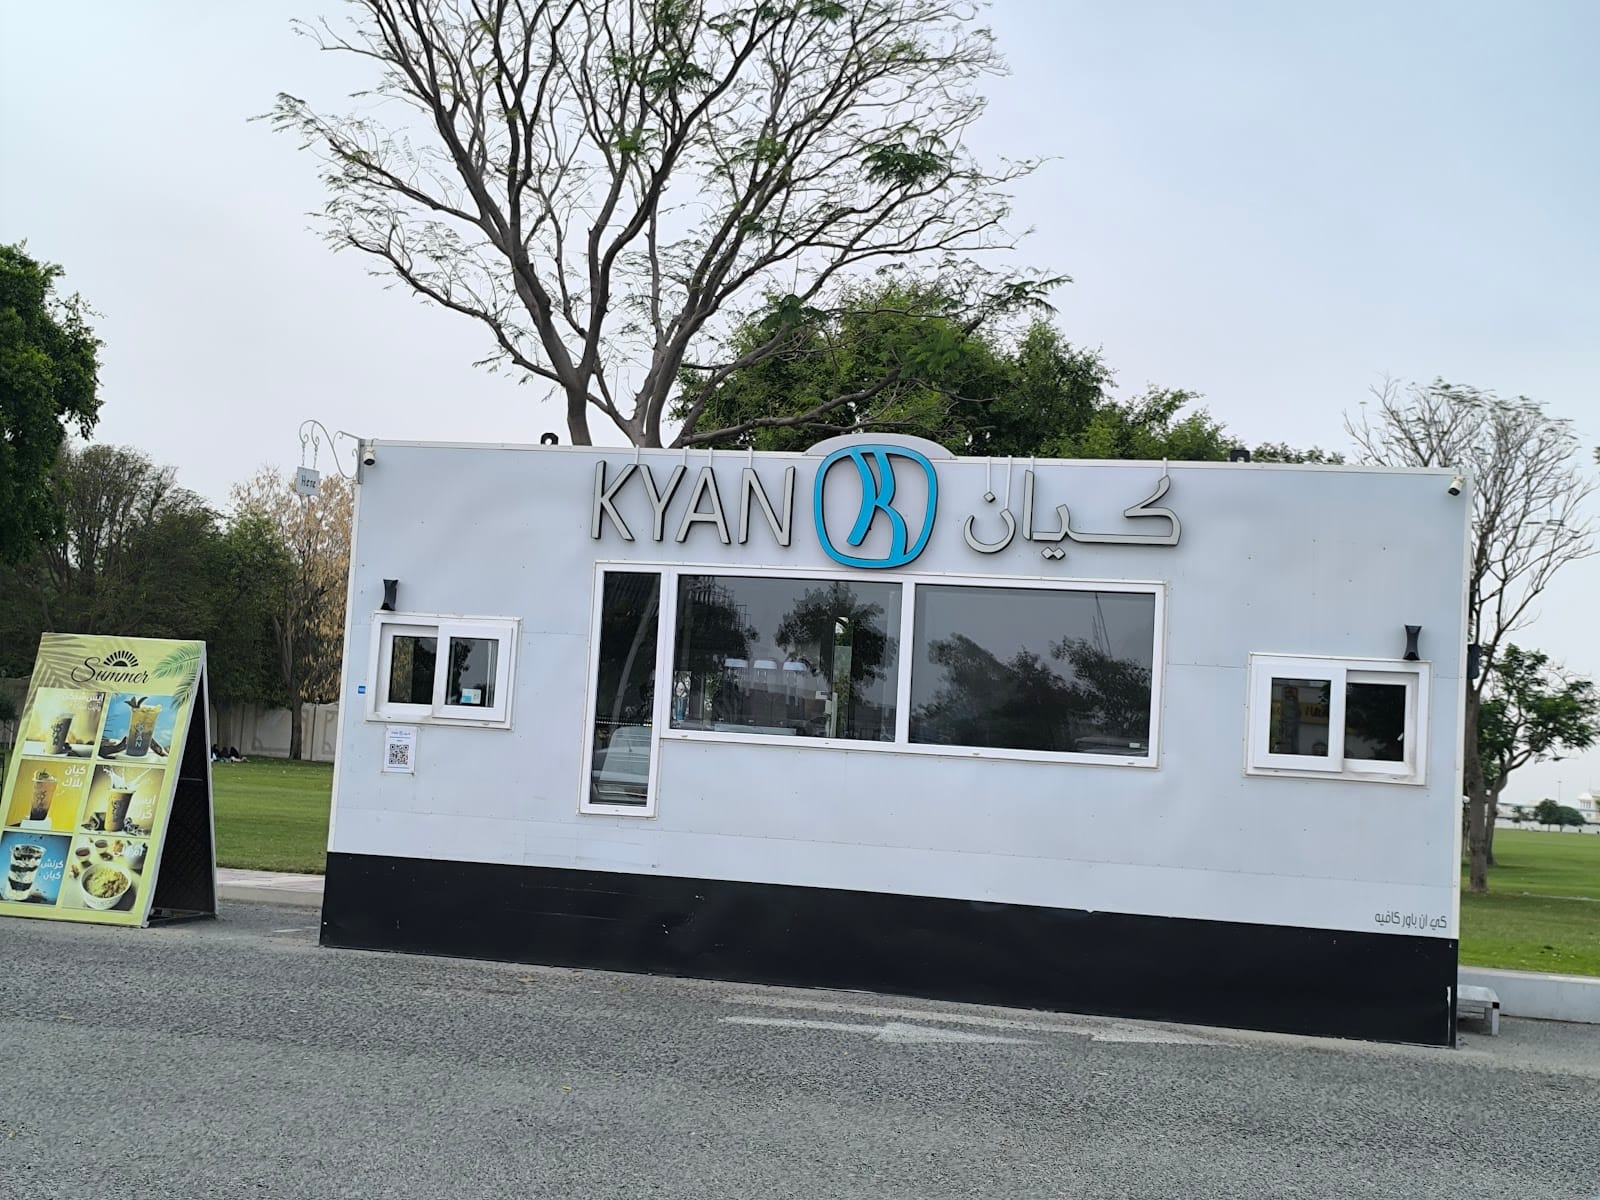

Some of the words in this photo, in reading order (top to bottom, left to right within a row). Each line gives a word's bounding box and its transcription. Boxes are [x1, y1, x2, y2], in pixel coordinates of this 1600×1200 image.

[591, 460, 796, 547] KYAN
[963, 469, 1182, 560] كيان
[71, 656, 149, 684] Summer
[64, 764, 87, 777] كيان
[42, 870, 62, 881] كيان
[1374, 910, 1401, 927] كافيه
[1401, 912, 1417, 929] باور
